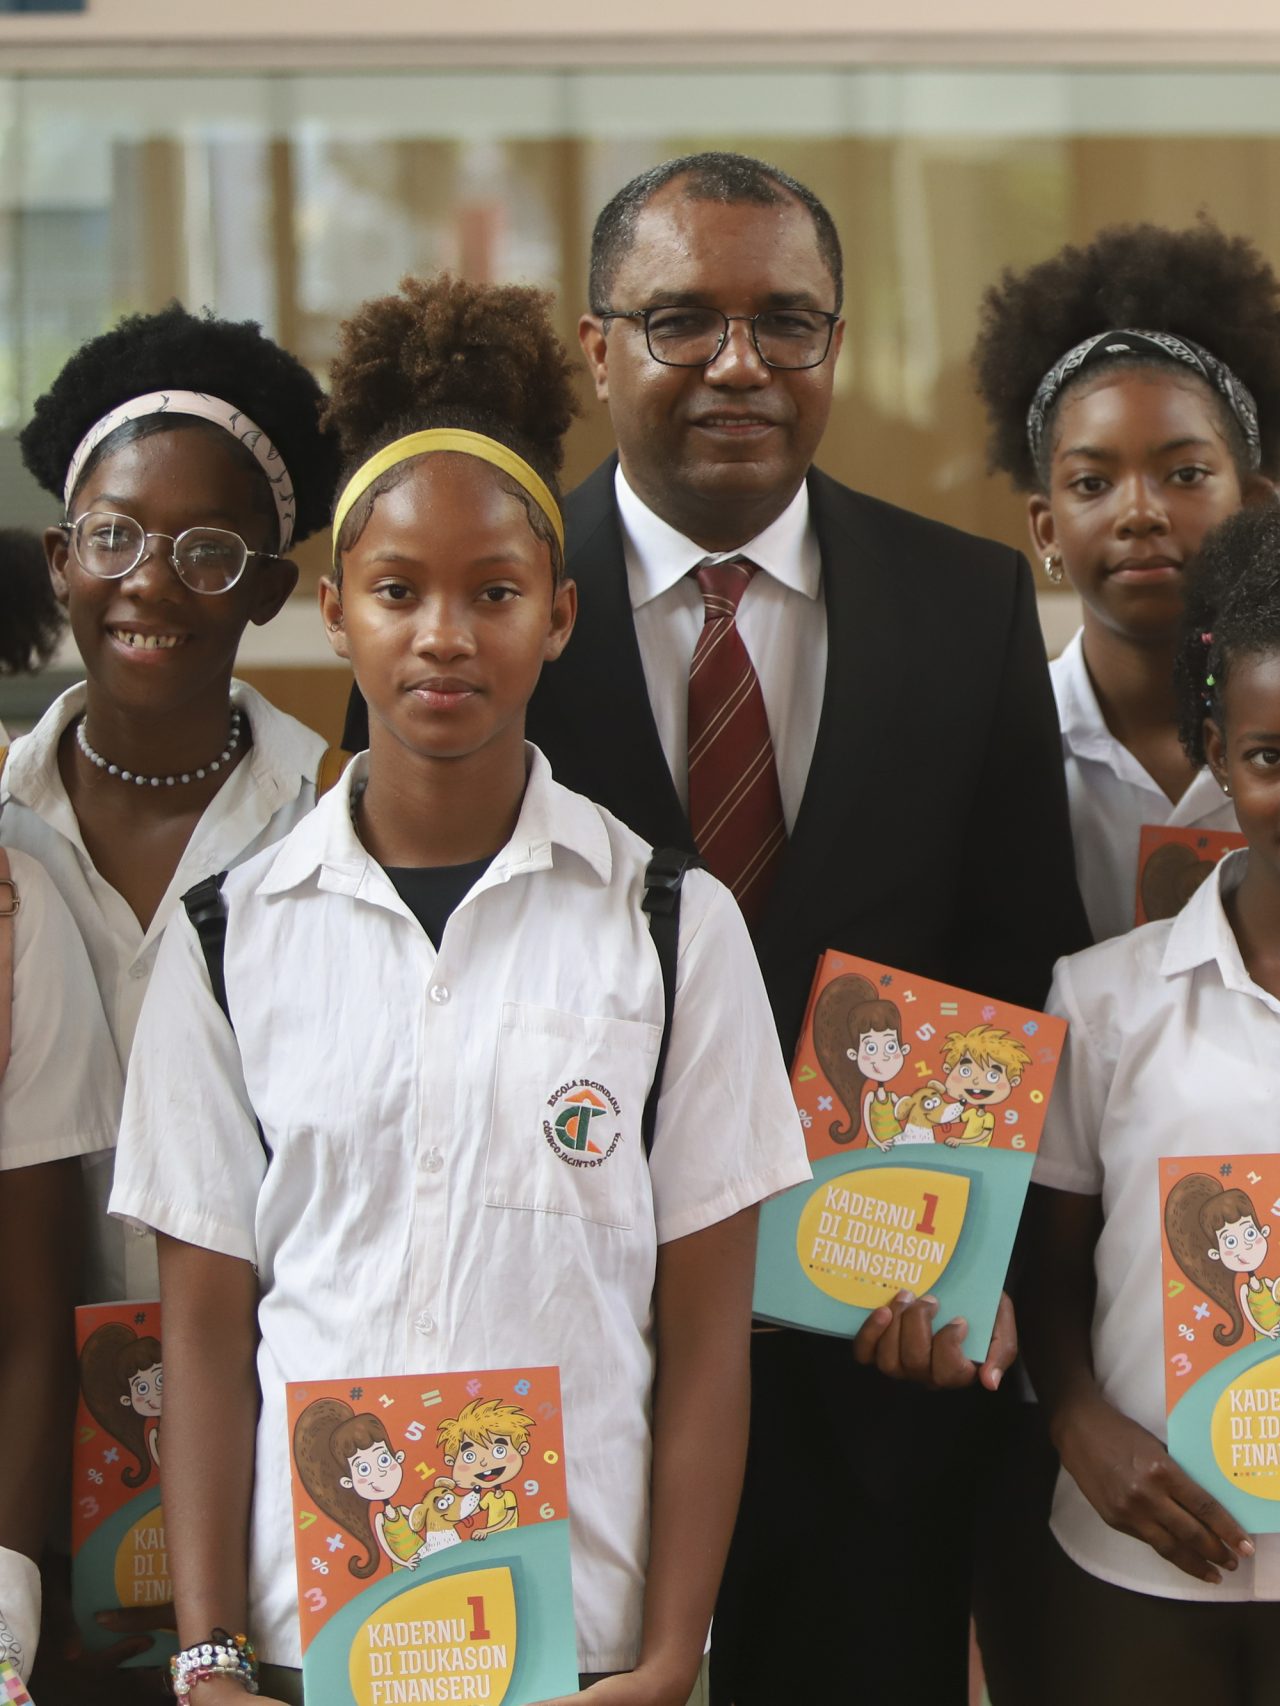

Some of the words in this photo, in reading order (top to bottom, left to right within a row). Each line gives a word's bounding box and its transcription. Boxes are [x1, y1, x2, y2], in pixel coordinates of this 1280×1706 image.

[904, 991, 916, 1002] 1
[916, 1023, 936, 1041] 5
[1023, 1021, 1038, 1036] 8
[915, 1061, 932, 1077] 1
[547, 1080, 578, 1107] ESCOLA
[1030, 1090, 1043, 1103] 0
[1005, 1110, 1018, 1124] 9
[1011, 1134, 1025, 1148] 6
[1247, 1171, 1261, 1184] 1
[825, 1185, 915, 1230] KADERNU
[915, 1192, 938, 1235] 1
[818, 1212, 842, 1238] DI
[843, 1219, 946, 1264] IDUKASON
[811, 1237, 922, 1284] FINANSERU
[1171, 1353, 1192, 1376] 3
[514, 1379, 531, 1396] 8
[379, 1394, 394, 1408] 1
[405, 1421, 425, 1440] 5
[1231, 1416, 1252, 1439] DI
[544, 1451, 558, 1464] 0
[415, 1462, 435, 1480] 1
[524, 1480, 539, 1496] 9
[540, 1503, 555, 1519] 6
[304, 1588, 327, 1612] 3
[367, 1618, 466, 1648] KADERNU
[467, 1596, 490, 1640] 1
[369, 1652, 393, 1677] DI
[399, 1645, 507, 1675] IDUKASON
[371, 1674, 490, 1705] FINANSERU
